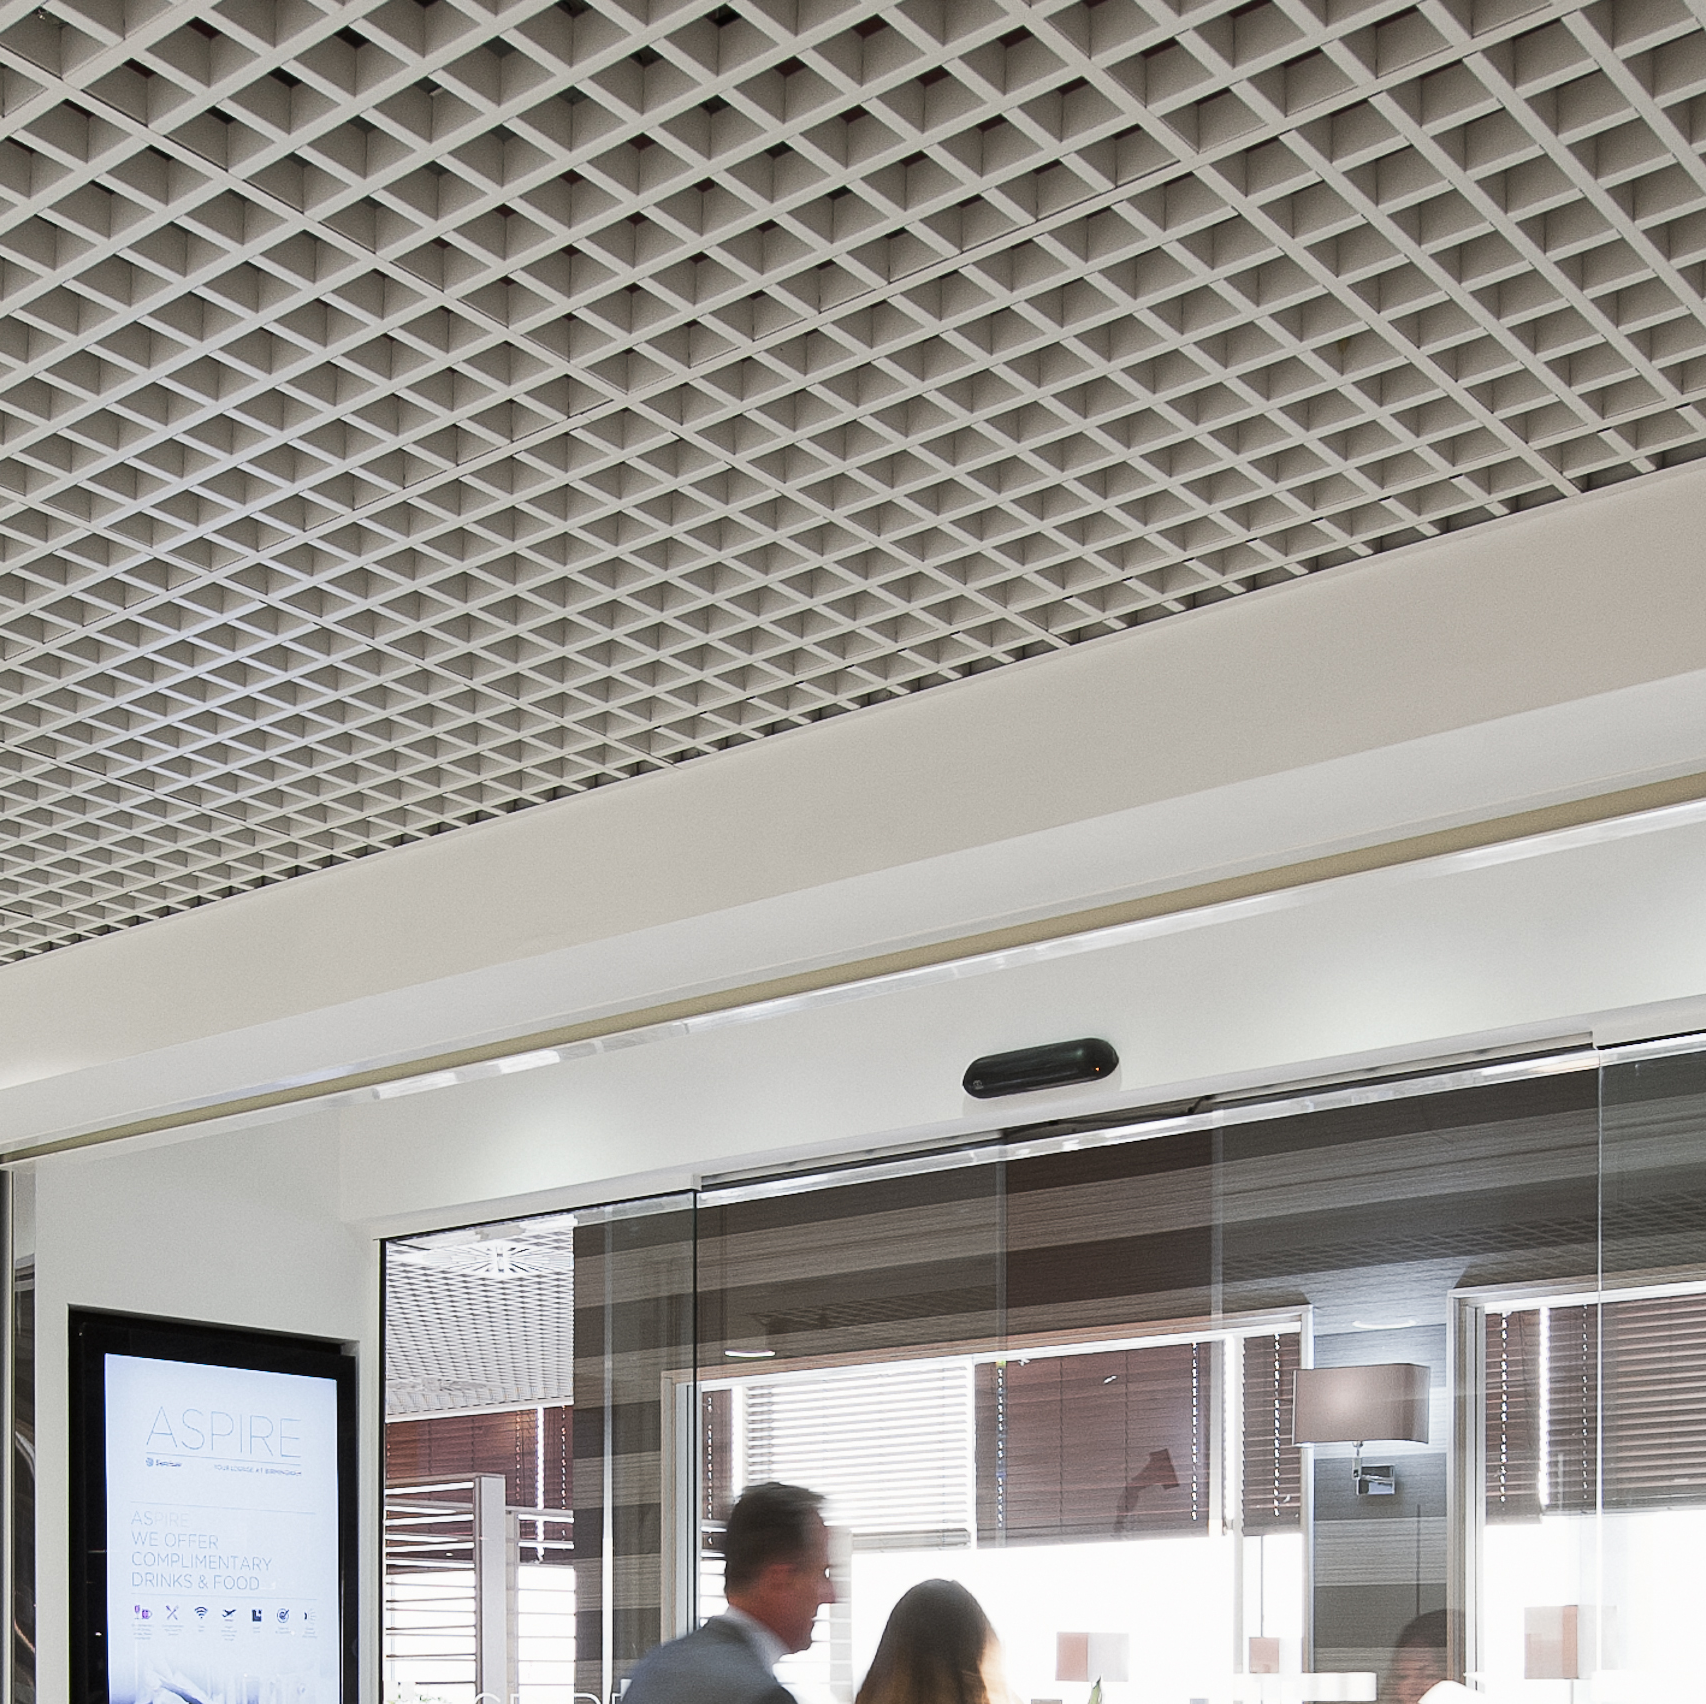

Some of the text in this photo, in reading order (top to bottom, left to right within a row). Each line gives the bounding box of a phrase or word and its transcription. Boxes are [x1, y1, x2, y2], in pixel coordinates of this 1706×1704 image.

[146, 1406, 302, 1458] ASPIRE
[130, 1510, 190, 1528] ASPIRE
[131, 1531, 219, 1550] WE OFFER
[131, 1551, 272, 1572] COMPLIMENTARY
[131, 1571, 260, 1591] DRINKS & FOOD
